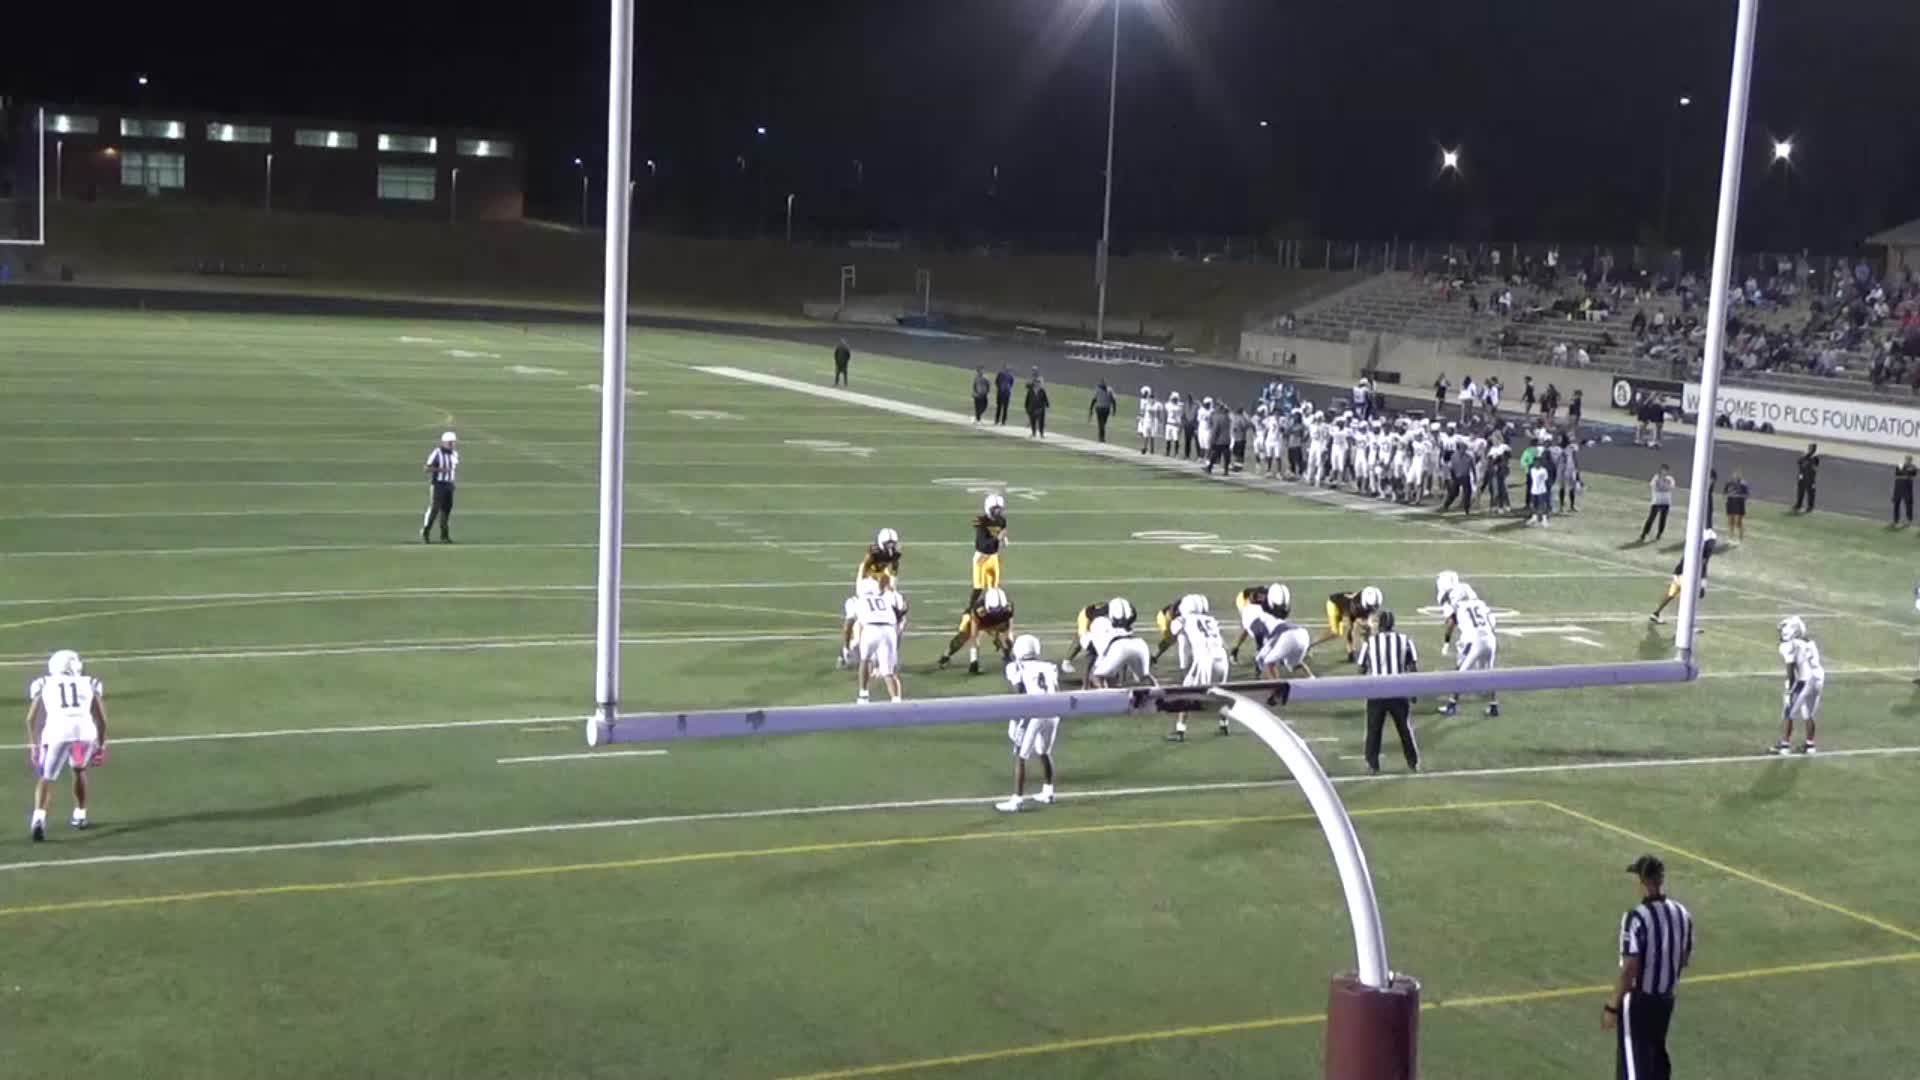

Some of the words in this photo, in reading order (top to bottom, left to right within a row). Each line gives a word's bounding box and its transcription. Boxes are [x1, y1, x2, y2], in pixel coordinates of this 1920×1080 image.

[1686, 391, 1757, 417] WCOME
[1761, 401, 1781, 420] TO
[1784, 404, 1818, 425] PLCS
[866, 597, 887, 612] 10
[1466, 606, 1486, 628] 15
[1036, 672, 1049, 692] 4
[58, 682, 81, 709] 11
